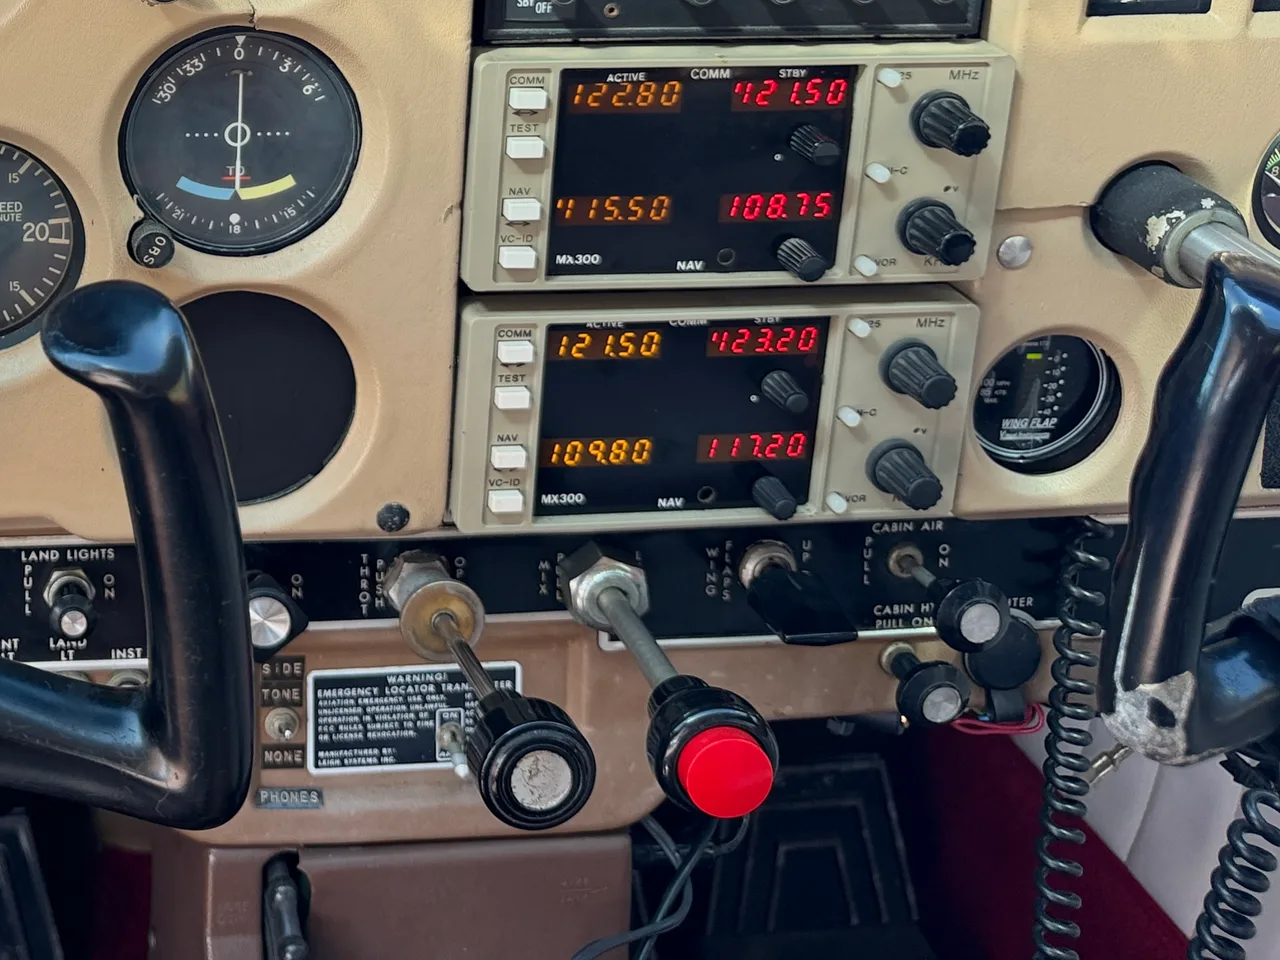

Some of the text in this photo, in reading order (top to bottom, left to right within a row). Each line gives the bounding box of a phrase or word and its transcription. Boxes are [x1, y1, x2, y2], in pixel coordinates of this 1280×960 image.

[536, 3, 552, 13] OFF
[607, 73, 646, 82] ACTIVE
[690, 69, 730, 79] COMM
[779, 69, 807, 78] STBY
[949, 70, 980, 80] MHz
[510, 76, 545, 85] COMM
[510, 124, 539, 132] TEST
[729, 193, 832, 220] 108.75
[23, 223, 49, 242] 20
[556, 254, 601, 265] MX300
[677, 261, 705, 270] NAV
[916, 318, 944, 328] MHz
[498, 330, 532, 338] COMM
[559, 332, 661, 358] 121.50
[1002, 418, 1057, 428] WING FLAP
[708, 432, 806, 457] 117.20
[541, 493, 585, 504] MX300
[658, 498, 684, 508] NAV
[872, 521, 943, 532] CABIN AIR
[21, 549, 114, 562] LAND LIGHTS
[874, 603, 913, 615] CABIN
[876, 617, 932, 628] PULL ON
[112, 648, 142, 659] INST
[387, 673, 447, 683] WARNING!
[262, 689, 300, 699] TONE
[318, 683, 435, 697] EMERGENCY LOCATOR
[265, 751, 302, 762] NONE
[261, 791, 318, 803] PHONES
